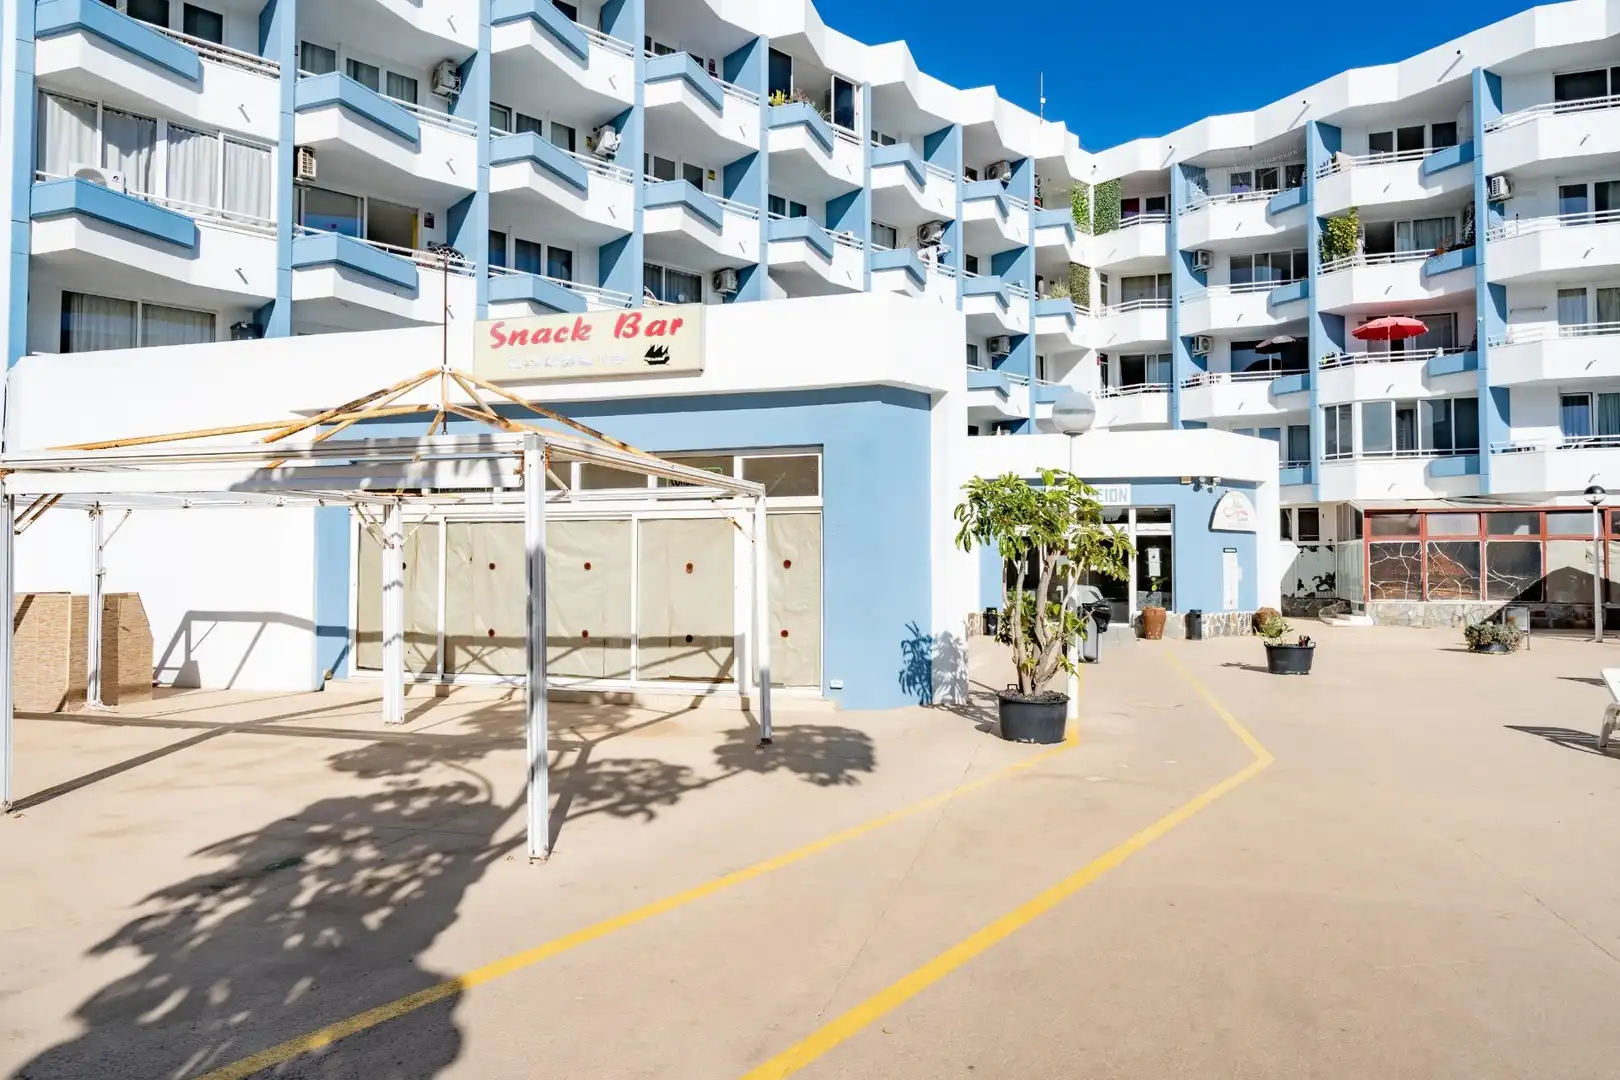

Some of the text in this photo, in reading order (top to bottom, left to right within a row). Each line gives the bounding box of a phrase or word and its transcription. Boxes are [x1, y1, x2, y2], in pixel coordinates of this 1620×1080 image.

[489, 312, 684, 349] Snack Bar
[1096, 488, 1127, 503] CION
